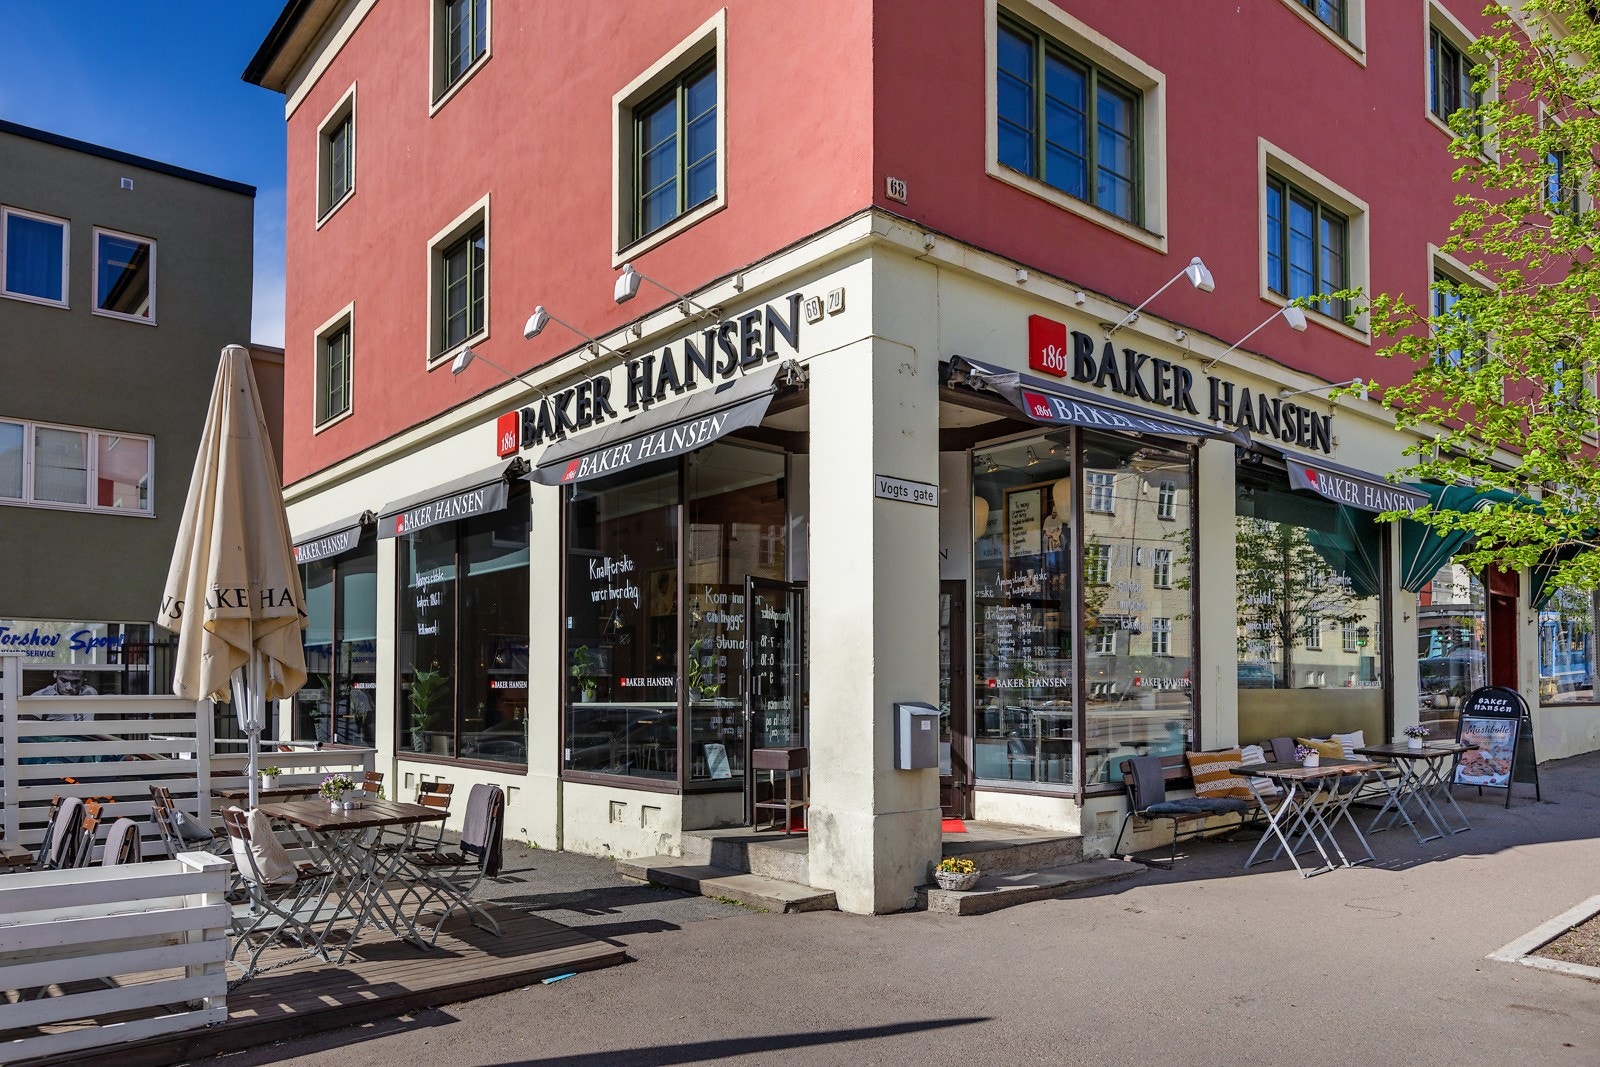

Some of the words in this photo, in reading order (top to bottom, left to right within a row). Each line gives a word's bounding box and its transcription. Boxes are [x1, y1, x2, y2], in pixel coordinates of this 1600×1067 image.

[890, 179, 904, 198] 68
[806, 300, 818, 319] 68
[829, 291, 840, 310] 70
[501, 430, 516, 452] 1861
[519, 375, 617, 450] BAKER
[624, 293, 803, 411] HANSEN
[1041, 344, 1067, 372] 1861
[1070, 330, 1200, 415] BAKER
[1207, 375, 1332, 454] HANSEN
[1034, 405, 1053, 417] 1861
[577, 442, 633, 479] BAKER
[636, 412, 730, 461] HANSEN
[880, 480, 909, 498] Vogts
[913, 489, 934, 501] gate
[1318, 473, 1361, 505] BAKER
[1364, 485, 1416, 514] HANSEN
[403, 506, 432, 532] BAKER
[434, 489, 485, 520] HANSEN
[298, 542, 322, 562] BAKER
[322, 532, 349, 554] HANSEN
[589, 554, 634, 582] Knallferske
[705, 585, 728, 604] Kom
[0, 626, 61, 646] Torshov
[69, 630, 125, 654] Sport
[26, 650, 55, 658] SERVICE
[494, 680, 509, 689] BAKER
[509, 680, 528, 689] HANSEN
[625, 677, 646, 687] BAKER
[646, 677, 674, 687] HANSEN
[996, 679, 1025, 688] BAKER
[1027, 678, 1067, 688] HANSEN
[1141, 677, 1161, 687] BAKER
[1163, 677, 1189, 687] HANSEN
